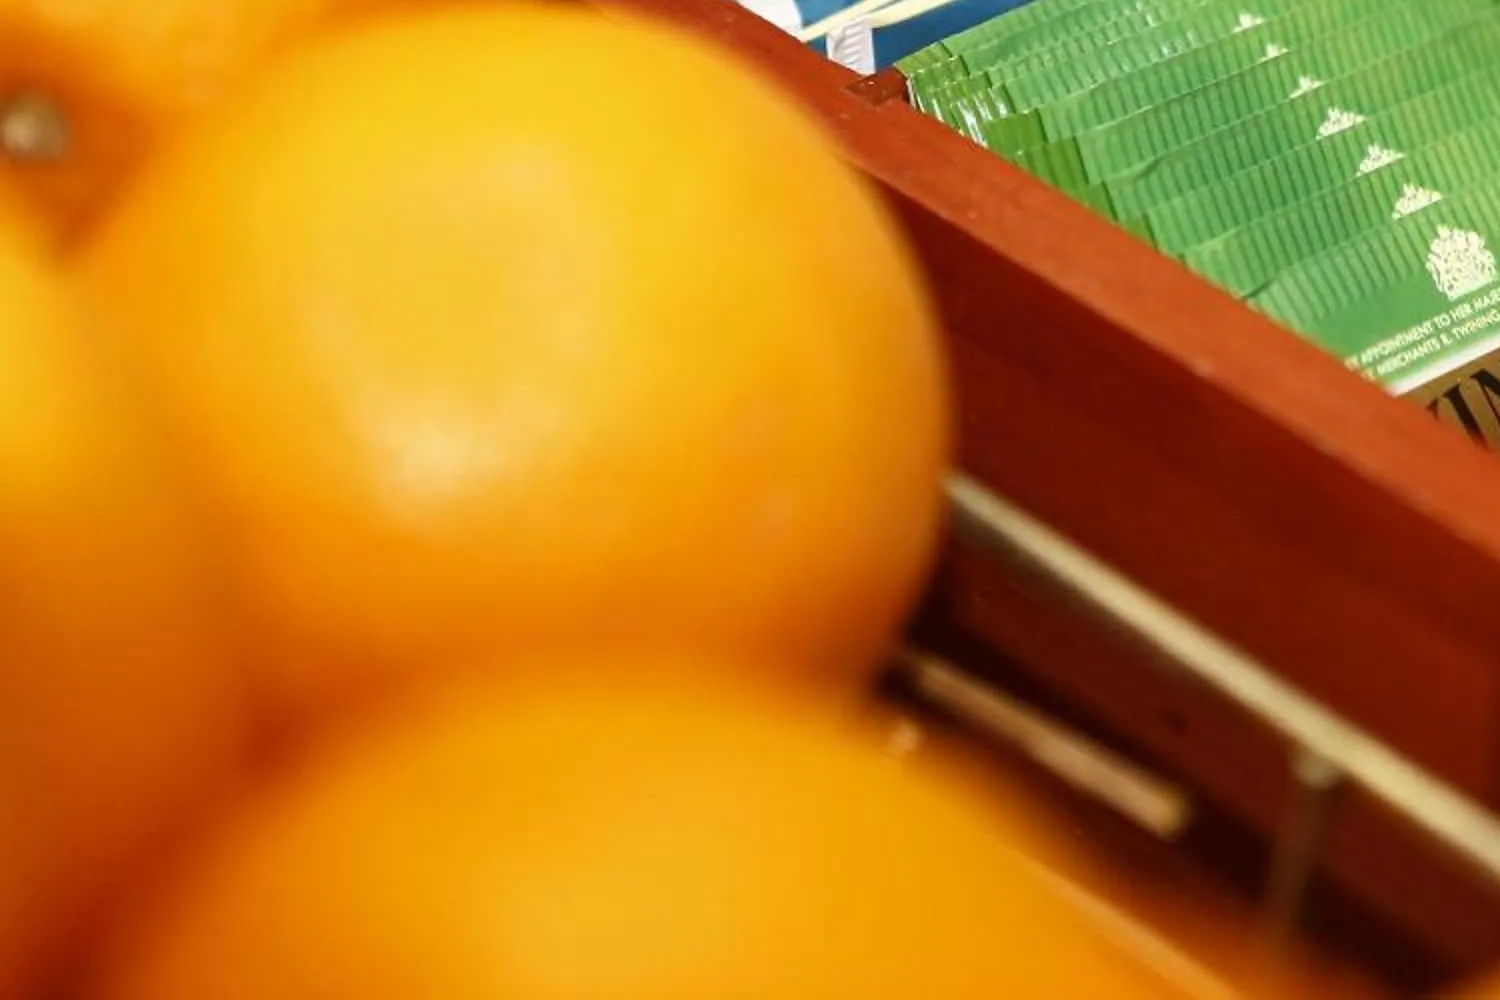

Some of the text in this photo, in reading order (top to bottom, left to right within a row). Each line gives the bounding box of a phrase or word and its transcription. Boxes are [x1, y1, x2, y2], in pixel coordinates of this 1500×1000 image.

[1360, 322, 1434, 366] APPOINTMENT
[1434, 312, 1451, 329] TO
[1450, 302, 1473, 322] HER
[1376, 337, 1441, 376] MERCHANTS
